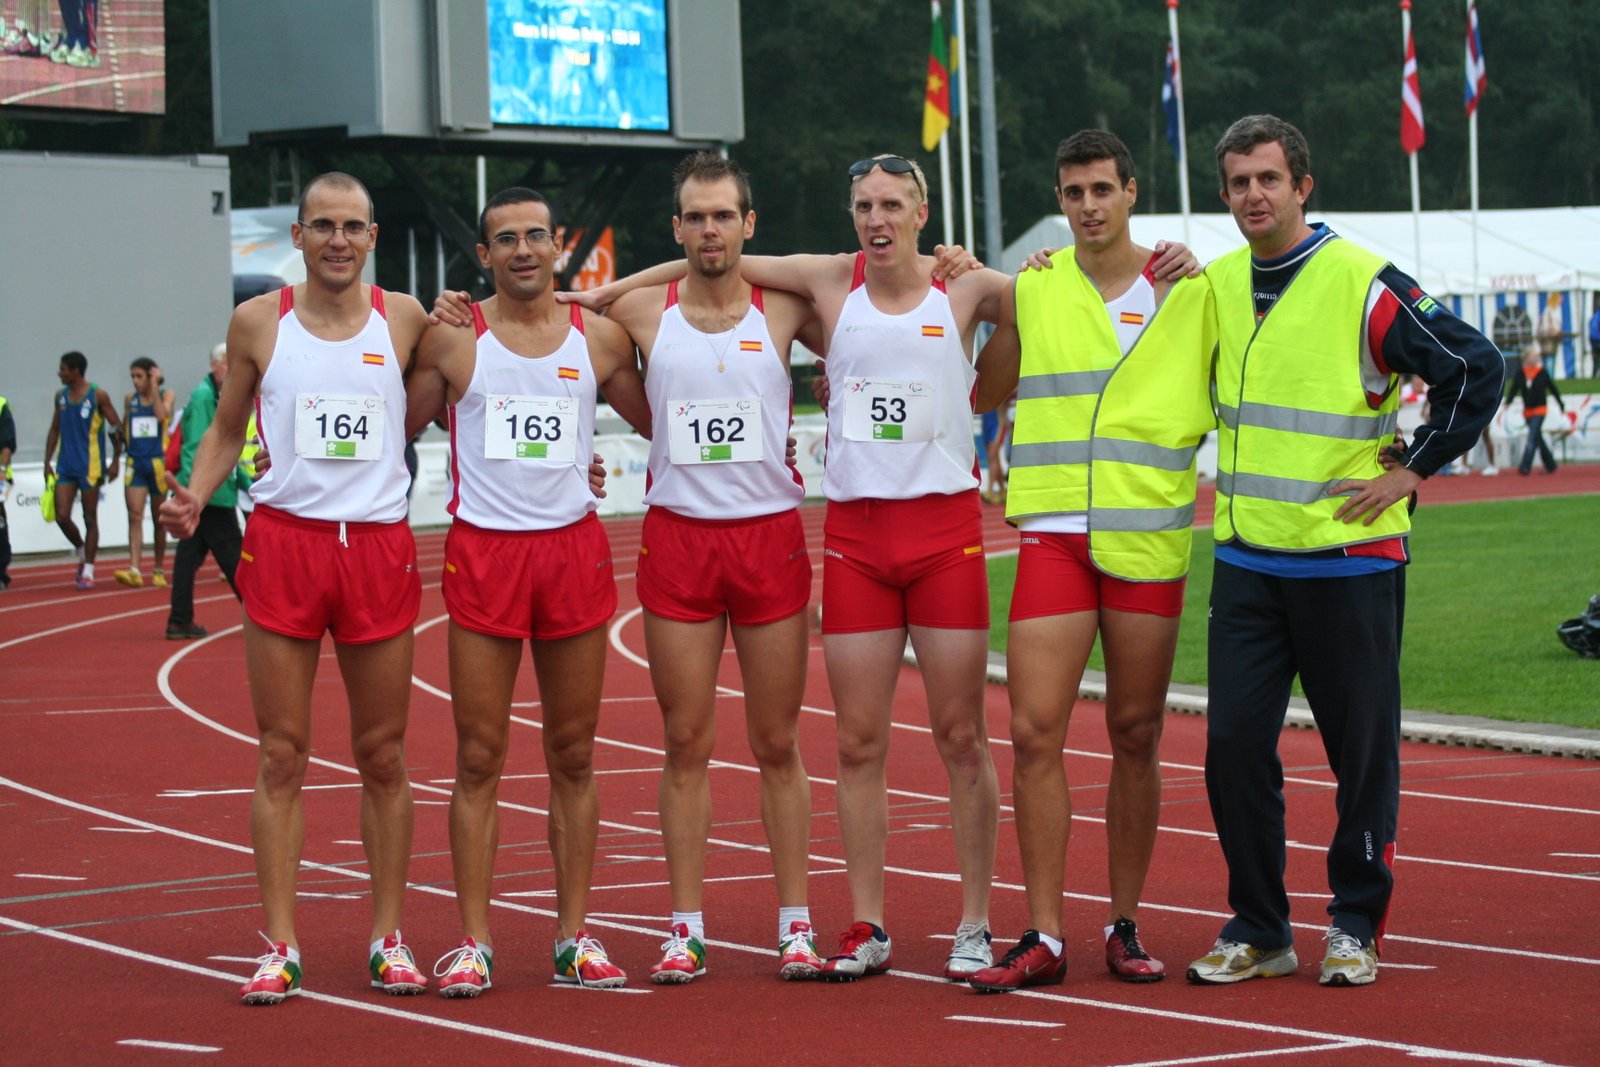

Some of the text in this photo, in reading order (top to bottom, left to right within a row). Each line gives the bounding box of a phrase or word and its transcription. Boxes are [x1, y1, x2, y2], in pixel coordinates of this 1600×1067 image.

[871, 396, 907, 423] 53
[316, 413, 368, 440] 164
[506, 414, 561, 442] 163
[688, 416, 745, 444] 162
